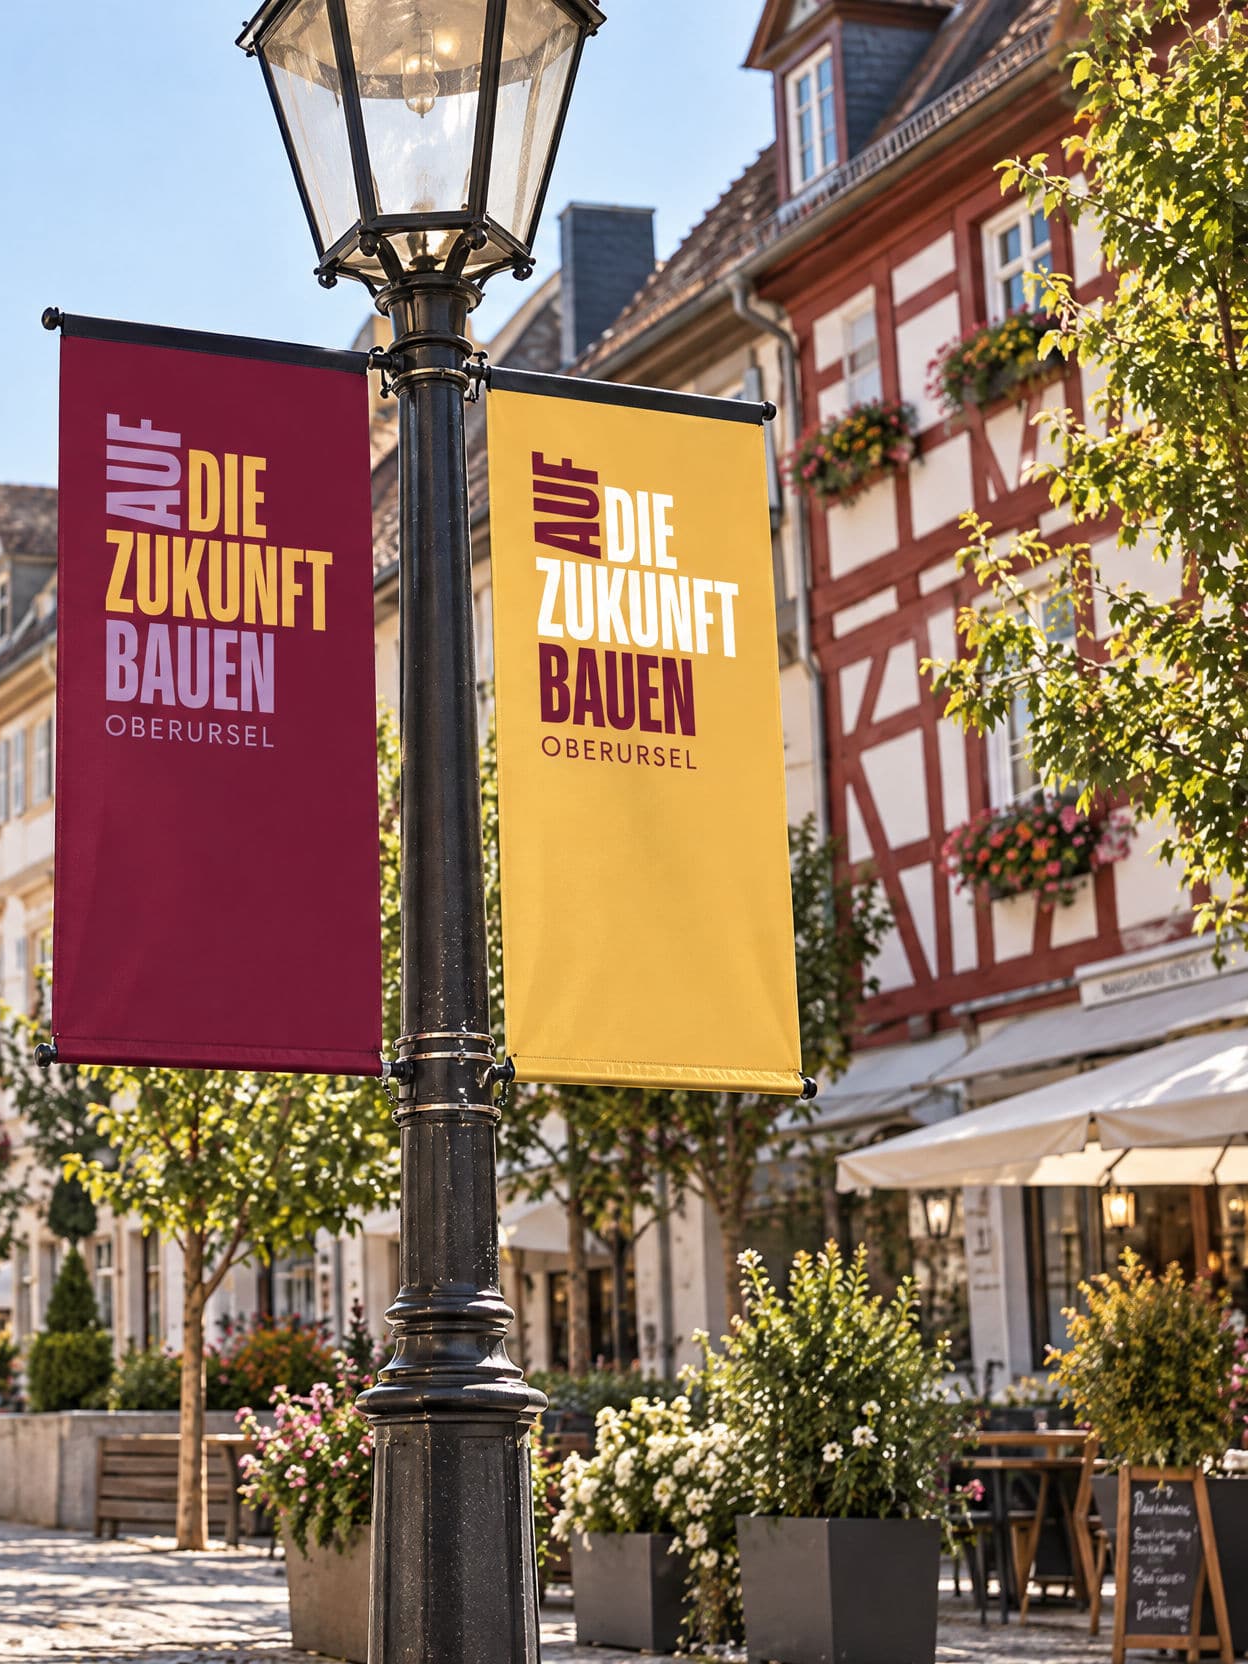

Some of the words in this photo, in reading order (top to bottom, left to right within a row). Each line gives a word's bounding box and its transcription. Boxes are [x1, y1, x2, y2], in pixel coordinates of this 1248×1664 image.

[106, 413, 181, 530] AUF
[188, 449, 267, 539] DIE
[532, 451, 602, 559] AUF
[604, 486, 678, 569] DIE
[105, 529, 333, 631] ZUKUNFT
[535, 556, 739, 658] ZUKUNFT
[106, 619, 275, 714] BAUEN
[538, 642, 697, 737] BAUEN
[106, 714, 275, 748] OBERURSEL
[541, 736, 698, 770] OBERURSEL
